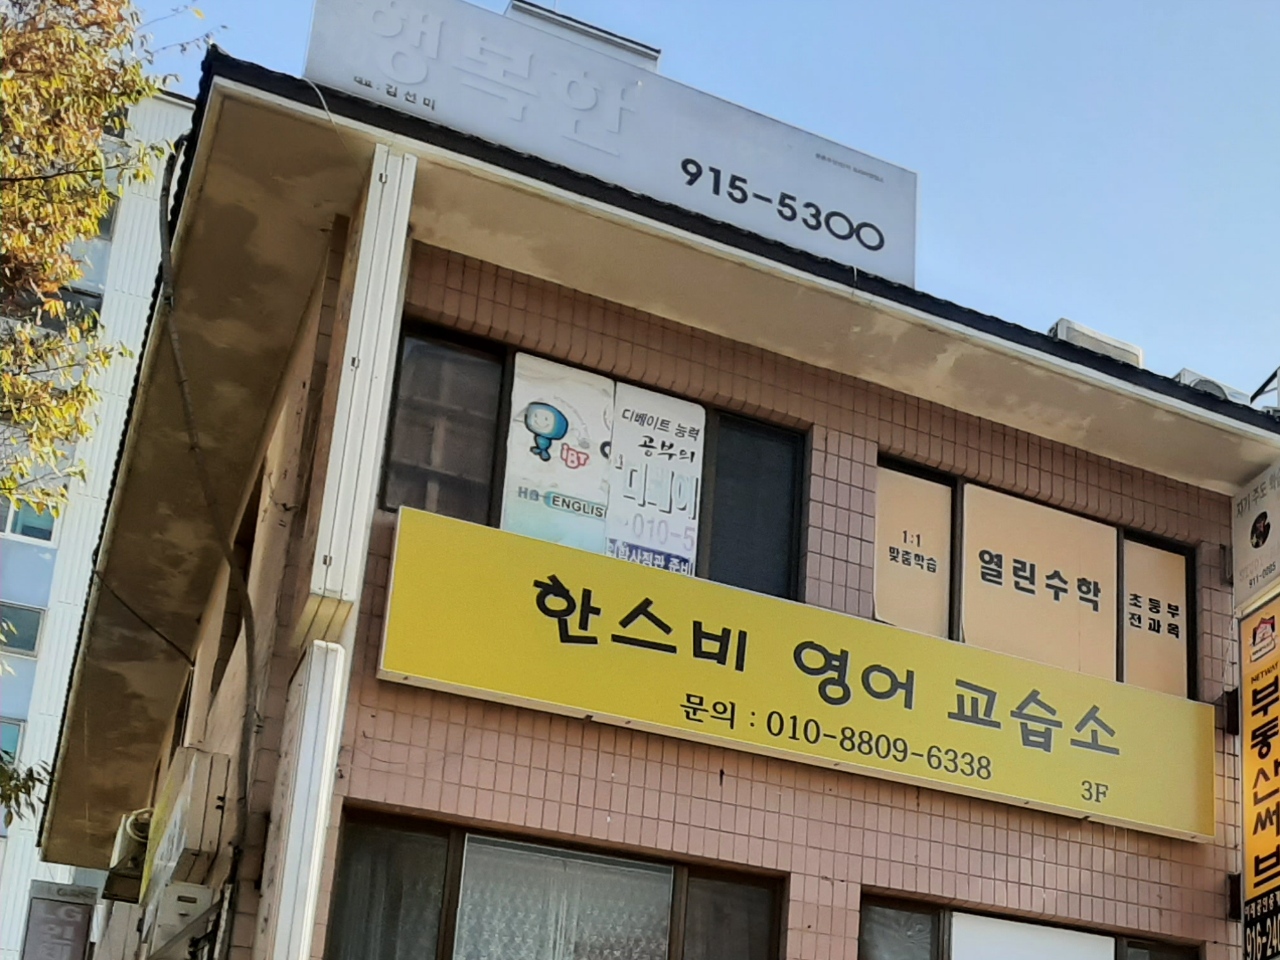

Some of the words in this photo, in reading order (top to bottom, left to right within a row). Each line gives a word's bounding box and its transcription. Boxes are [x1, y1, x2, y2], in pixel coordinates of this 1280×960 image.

[680, 157, 885, 251] 915-5300
[621, 409, 671, 431] 디베이트
[902, 529, 922, 548] 1:1
[888, 546, 937, 573] 맞춤학습
[978, 549, 1101, 613] 열린수학
[1129, 593, 1180, 619] 초등부
[532, 574, 747, 673] 한스비
[793, 640, 916, 709] 영어
[947, 677, 1123, 756] 교습소
[680, 692, 737, 730] 문의
[765, 709, 993, 782] 010-8809-6338
[1080, 779, 1110, 803] 3F
